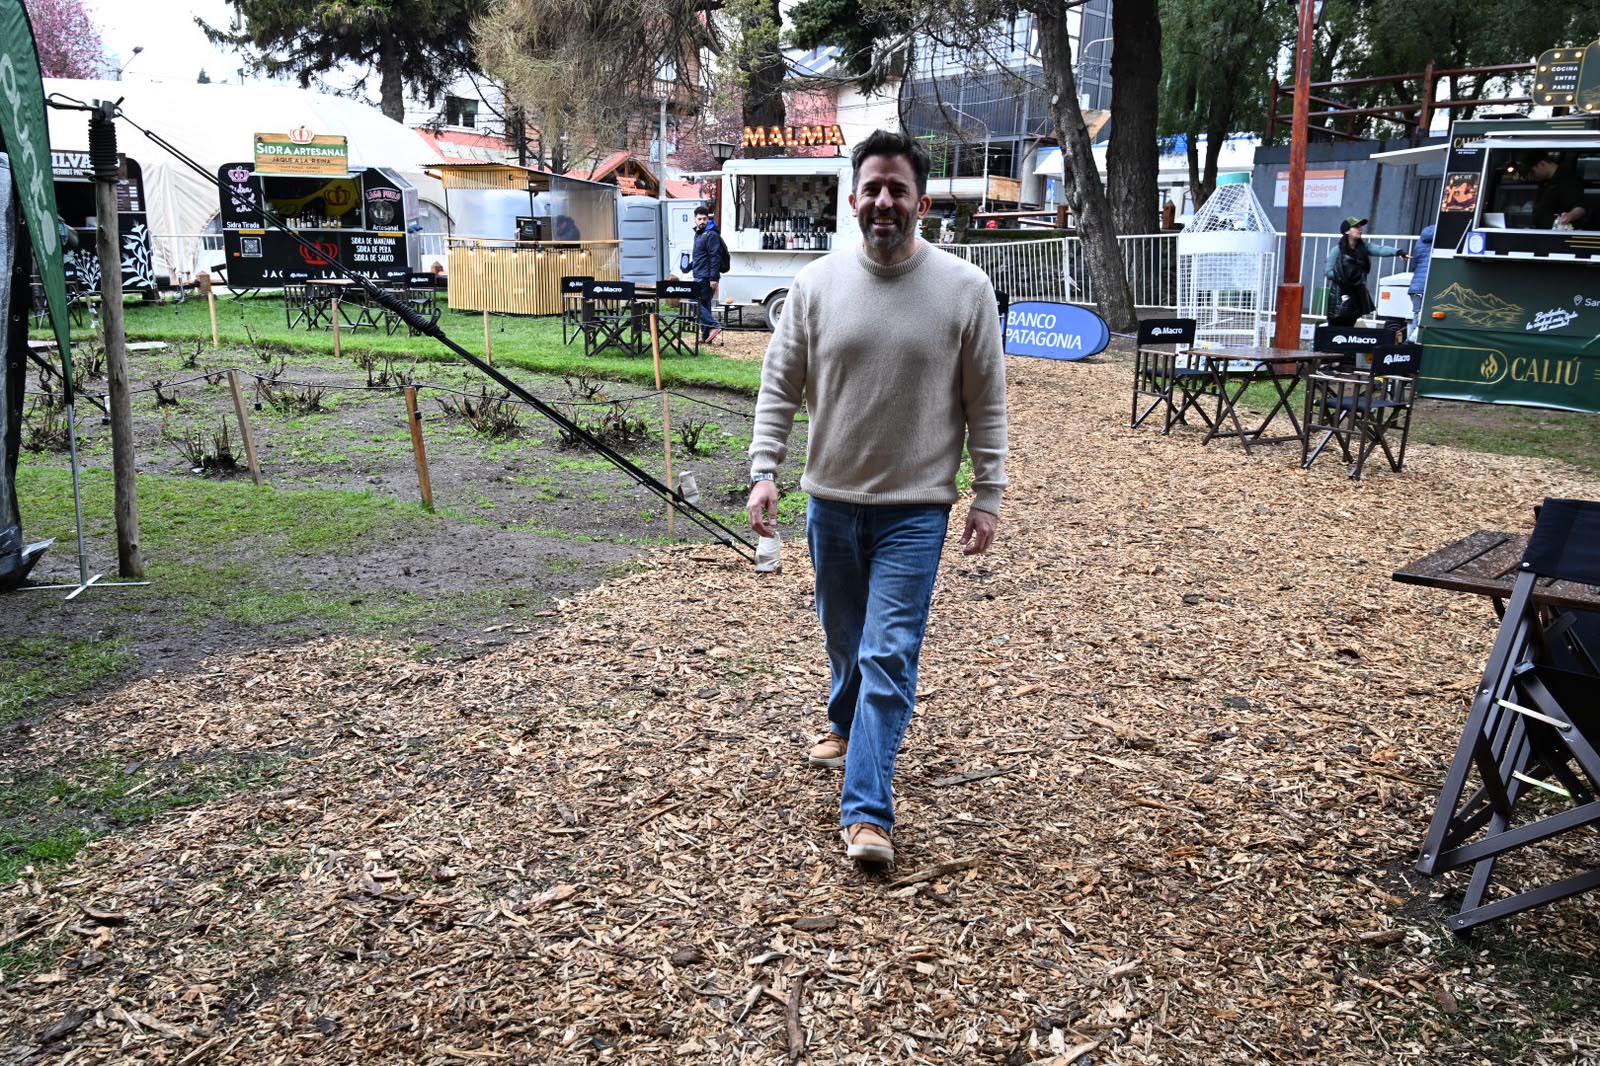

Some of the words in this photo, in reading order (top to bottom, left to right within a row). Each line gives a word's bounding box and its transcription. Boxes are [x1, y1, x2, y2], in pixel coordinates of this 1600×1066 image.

[743, 124, 846, 148] MALMA
[294, 147, 346, 157] ARTESANAL
[227, 221, 242, 229] Sidra
[351, 237, 366, 245] SIDRA
[366, 237, 373, 245] DE
[356, 245, 371, 253] SIDRA
[379, 246, 392, 254] PERA
[353, 253, 369, 262] SIDRA
[369, 254, 377, 262] DE
[321, 270, 337, 279] LA
[602, 285, 623, 293] Macro
[1007, 311, 1057, 330] BANCO
[1161, 327, 1183, 335] Macro
[1005, 328, 1082, 350] PATAGONIA
[1347, 335, 1377, 344] Macro
[1393, 353, 1411, 362] Macro
[1510, 356, 1583, 386] CALIÚ
